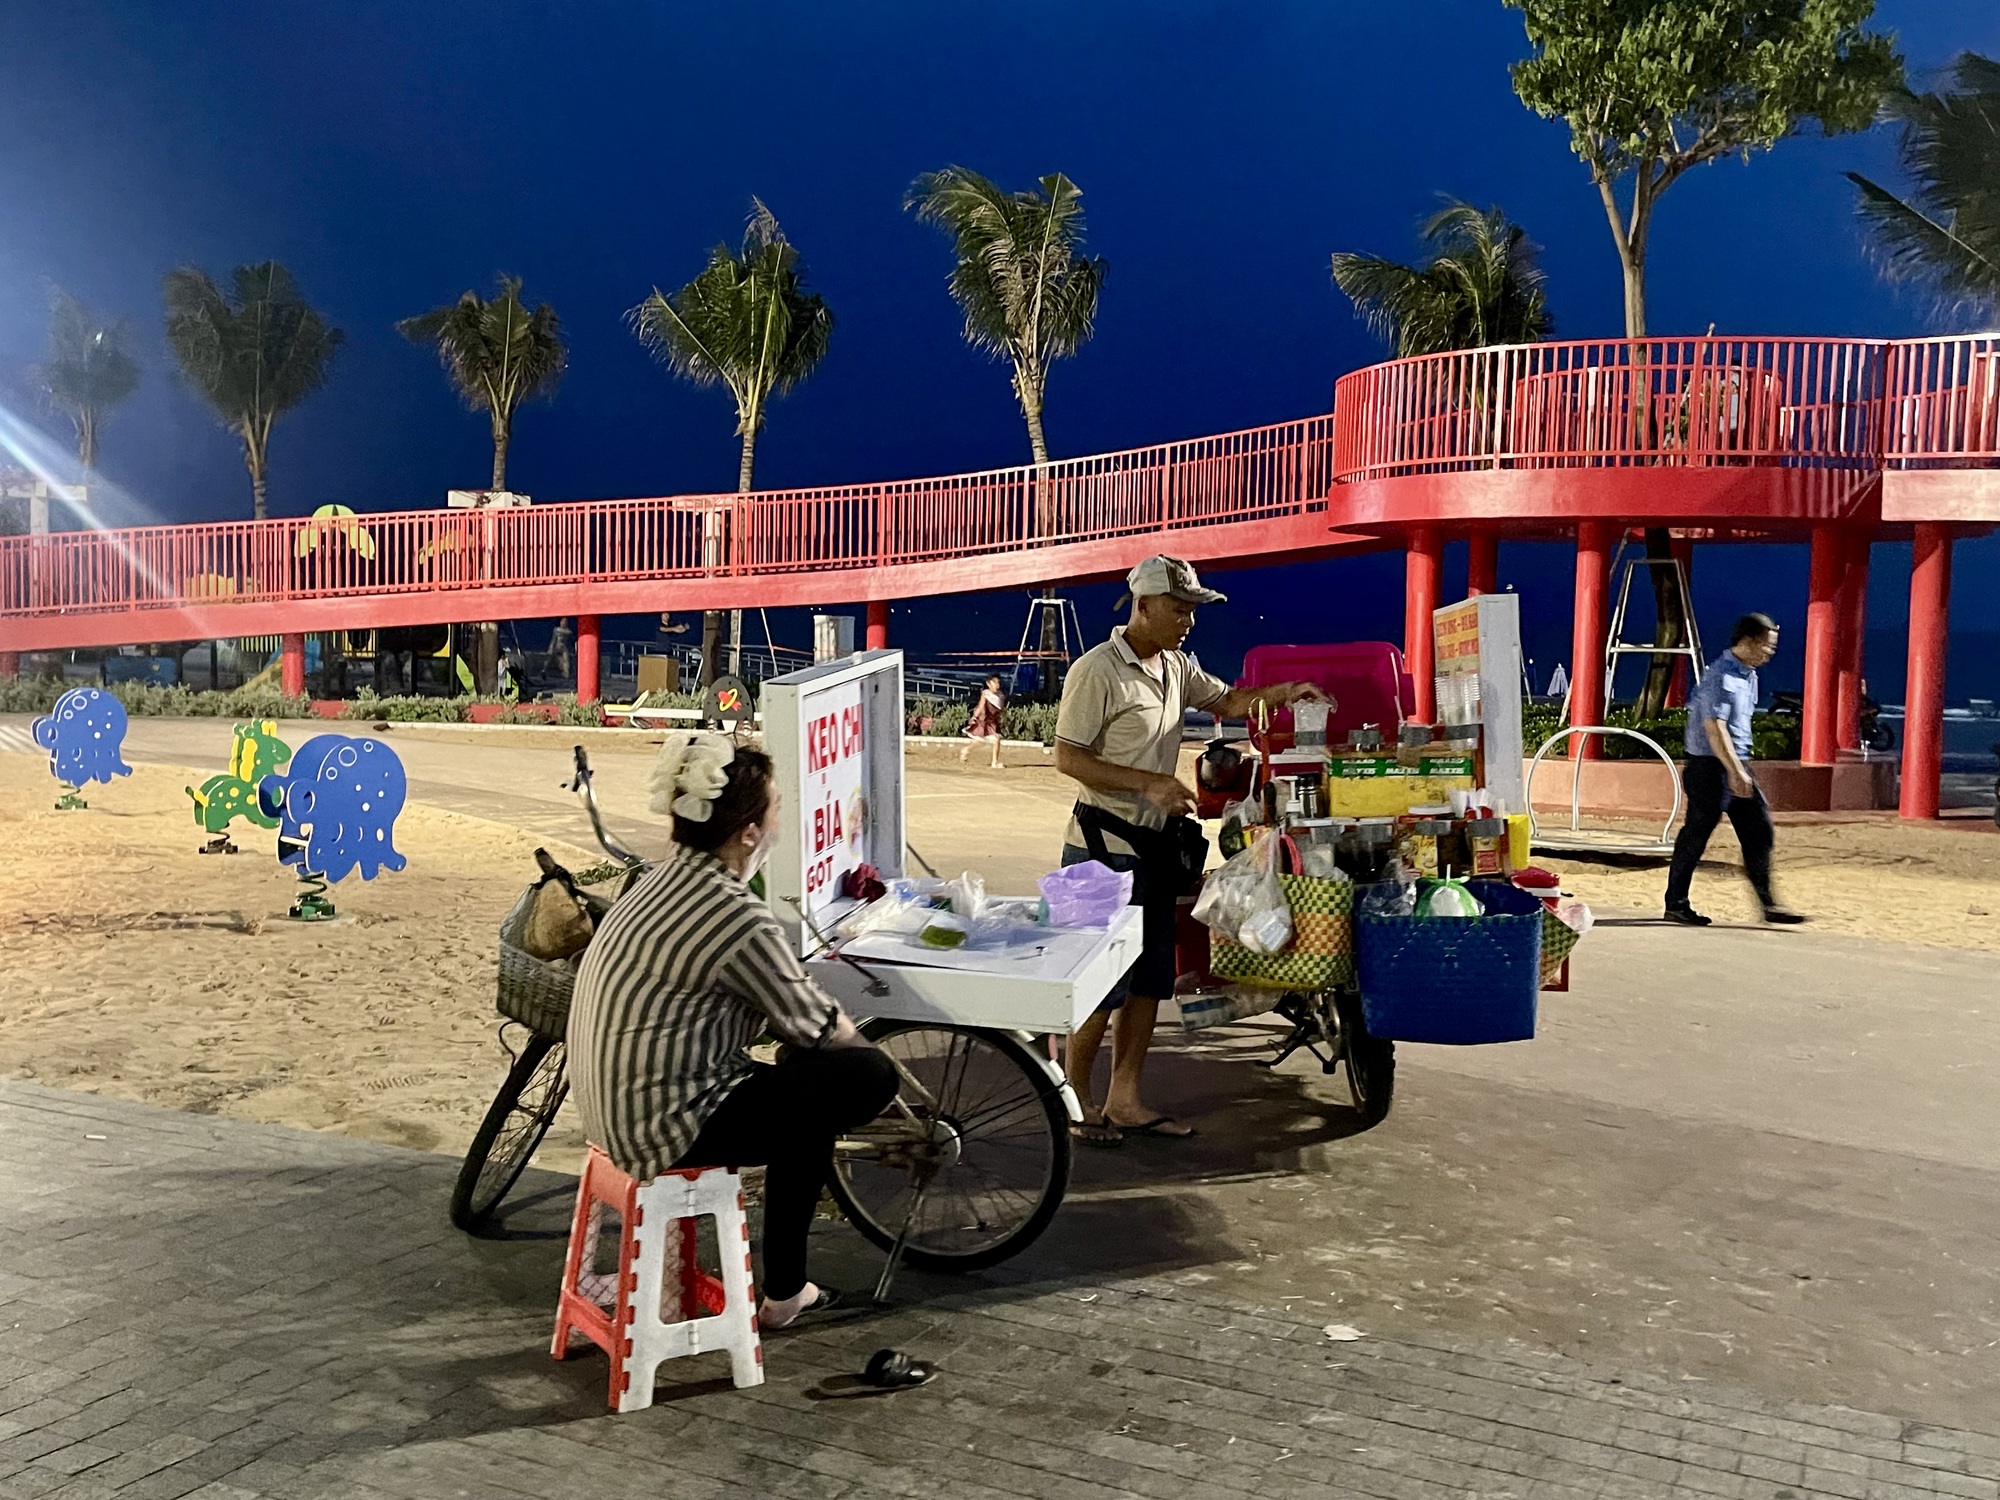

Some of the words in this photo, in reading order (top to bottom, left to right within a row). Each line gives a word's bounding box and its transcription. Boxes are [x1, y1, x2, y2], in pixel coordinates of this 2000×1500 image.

[808, 712, 838, 785] KẸO
[814, 790, 843, 853] BÍA
[807, 855, 834, 894] GỌT
